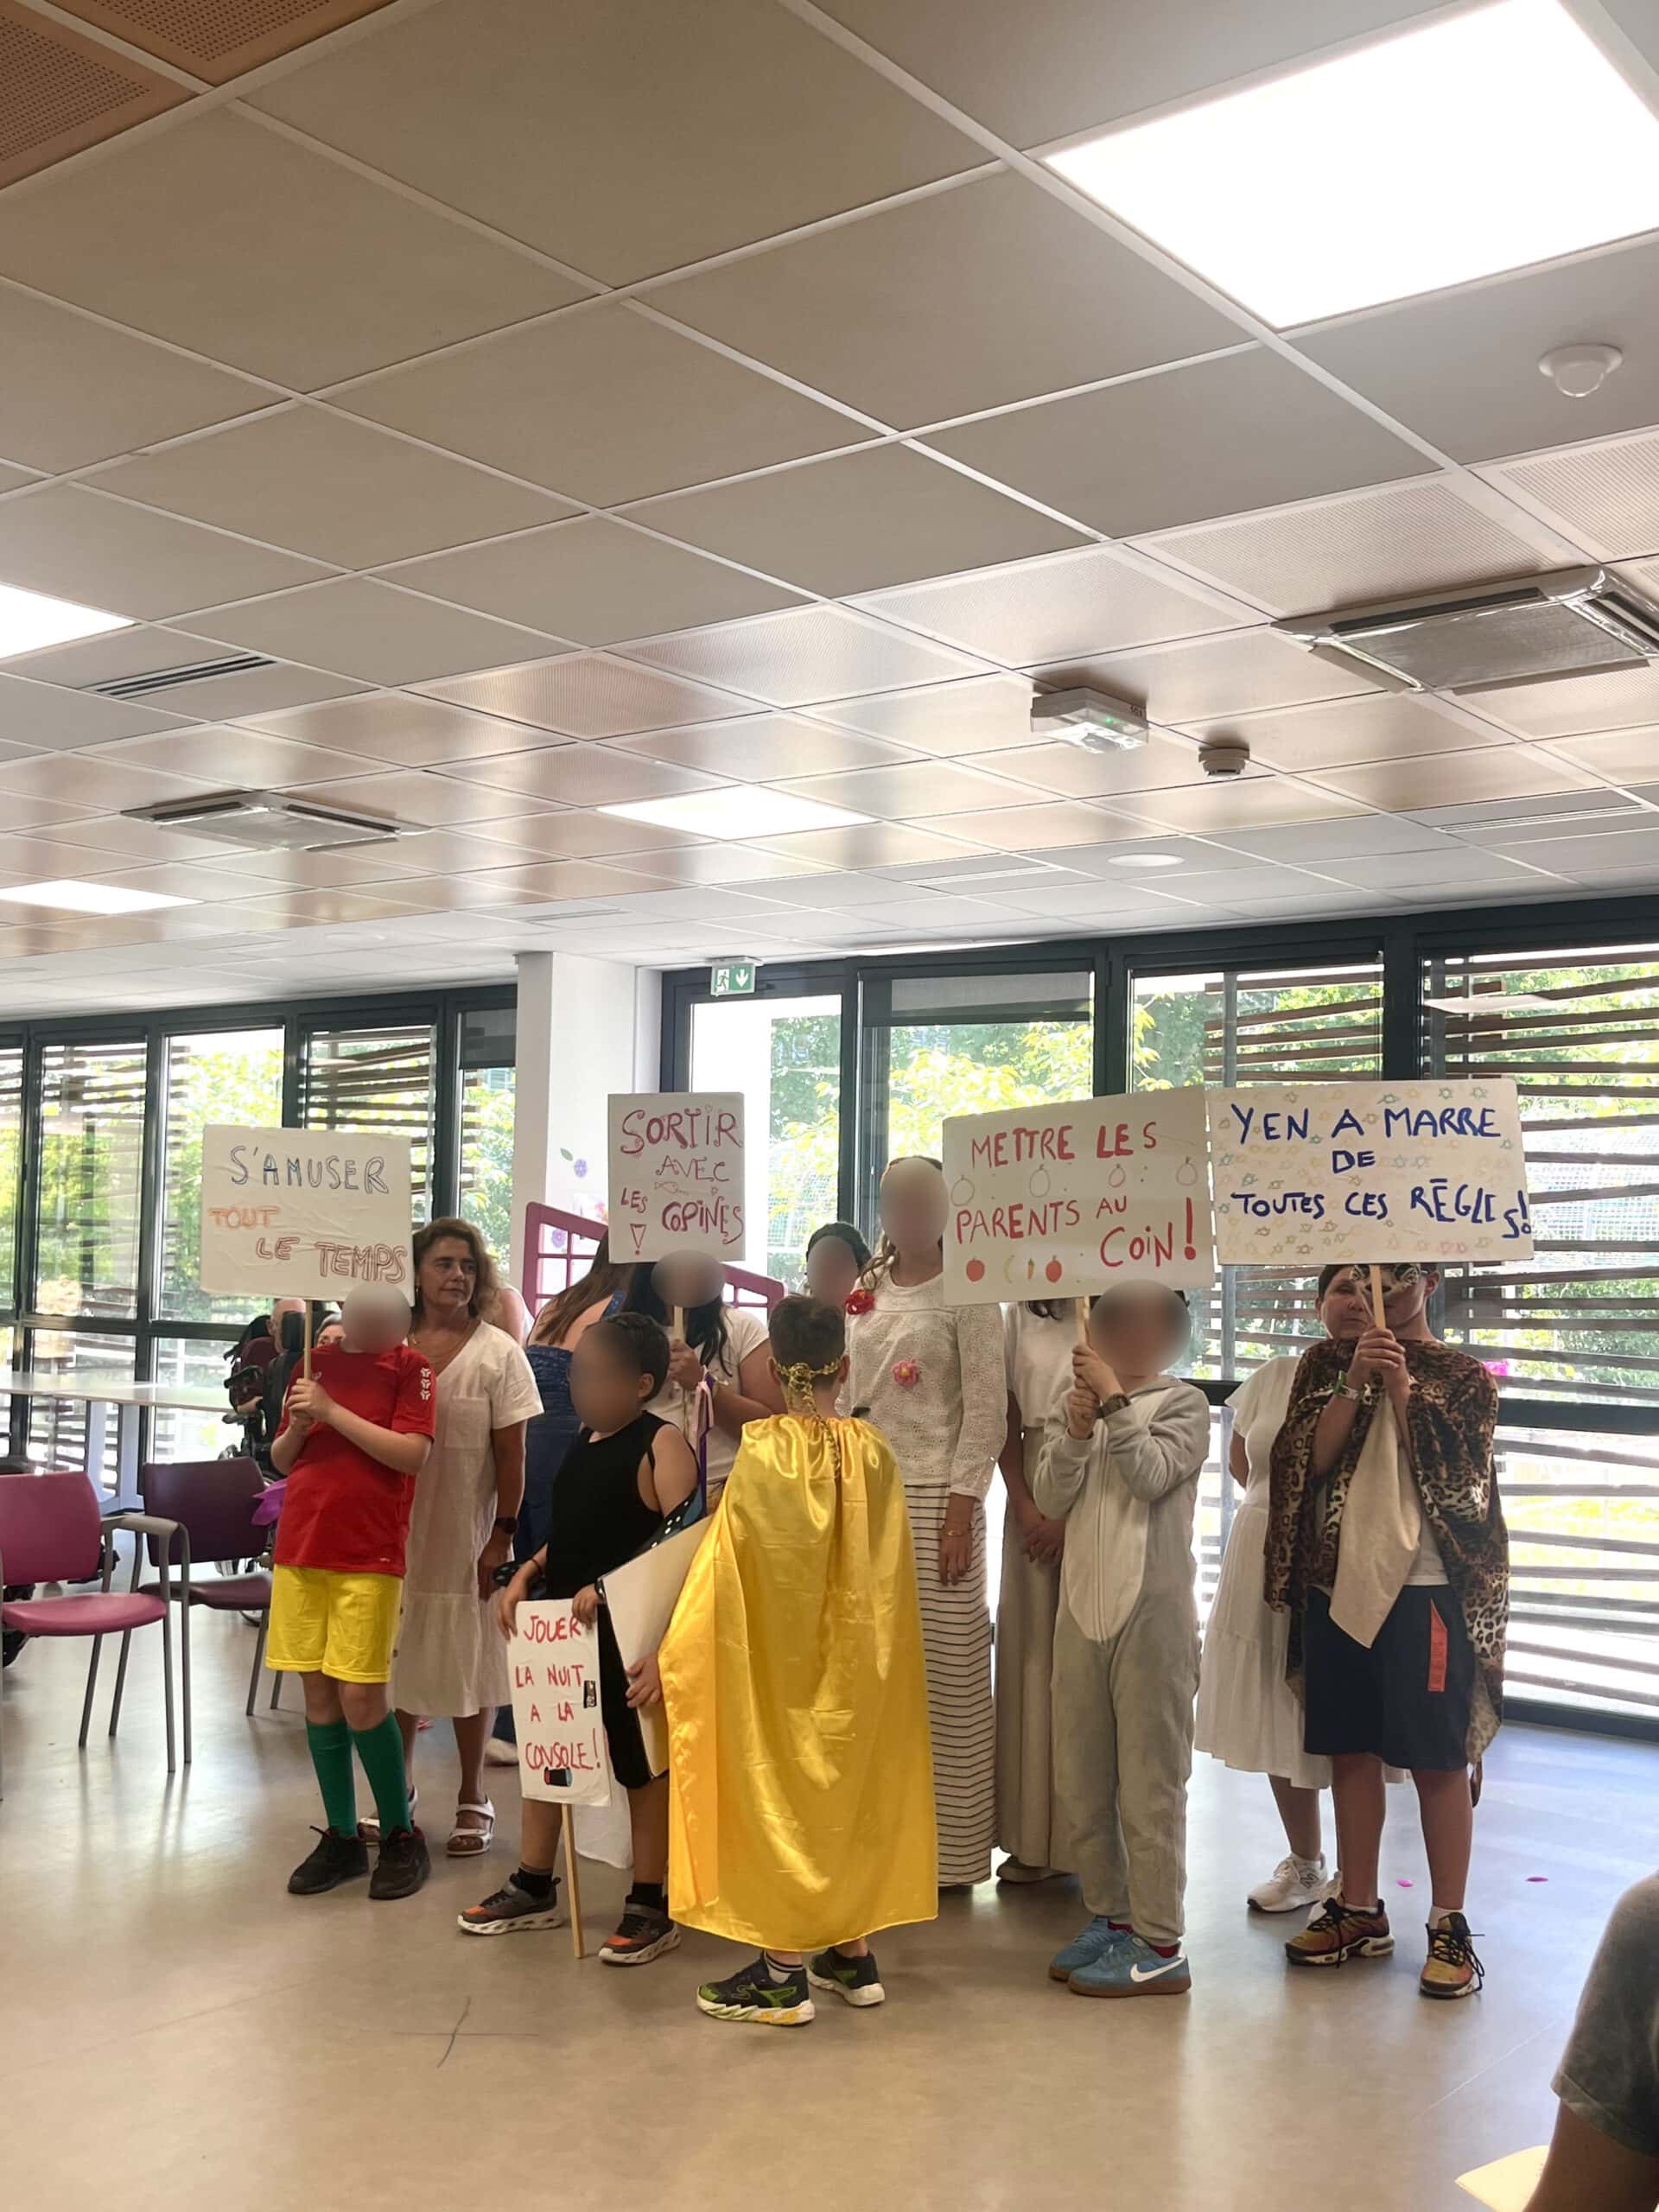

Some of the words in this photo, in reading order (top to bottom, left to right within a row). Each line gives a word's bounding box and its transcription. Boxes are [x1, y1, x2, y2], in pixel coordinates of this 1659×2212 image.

[1331, 1109, 1365, 1138] A
[1383, 1107, 1502, 1138] MARRE
[970, 1124, 1076, 1168] METTRE
[1096, 1122, 1158, 1159] LES
[229, 1145, 390, 1194] S'AMUSER
[655, 1154, 730, 1182] AVEC
[1331, 1149, 1376, 1173] DE
[620, 1186, 649, 1214] LES
[1230, 1192, 1325, 1220] TOUTES
[1344, 1192, 1389, 1220] CES
[207, 1205, 281, 1230] TOUT
[956, 1199, 1080, 1244] PARENTS
[1096, 1195, 1128, 1219] AU
[256, 1236, 300, 1260] LE
[315, 1241, 409, 1285] TEMPS
[523, 1615, 582, 1643] JOUER
[515, 1665, 534, 1688] LA
[546, 1663, 584, 1688] NUIT
[530, 1704, 541, 1722] A
[557, 1700, 575, 1721] LA
